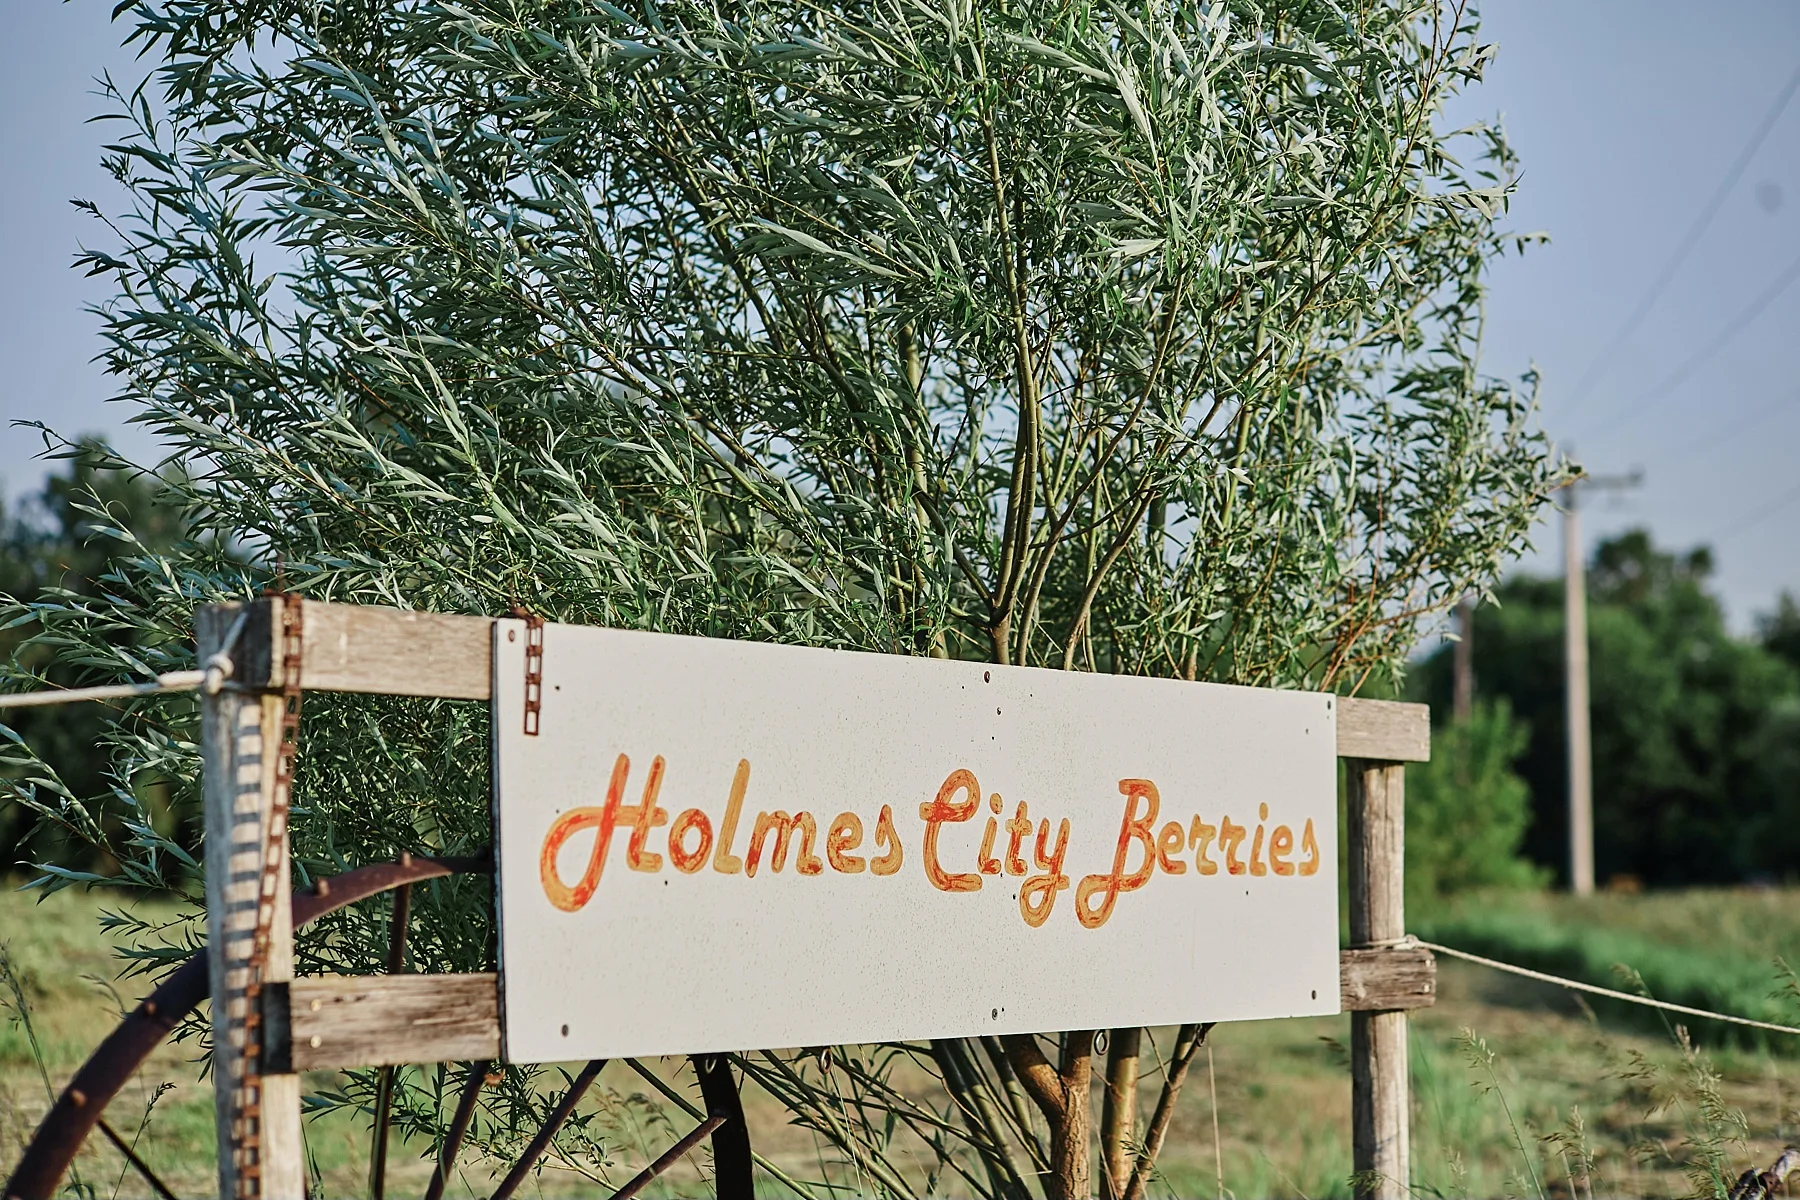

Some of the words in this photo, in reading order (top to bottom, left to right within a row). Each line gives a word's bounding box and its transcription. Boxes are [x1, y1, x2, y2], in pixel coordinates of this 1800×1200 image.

[539, 752, 904, 913] Holmes
[919, 768, 1071, 929] City
[1074, 778, 1320, 931] Berries
